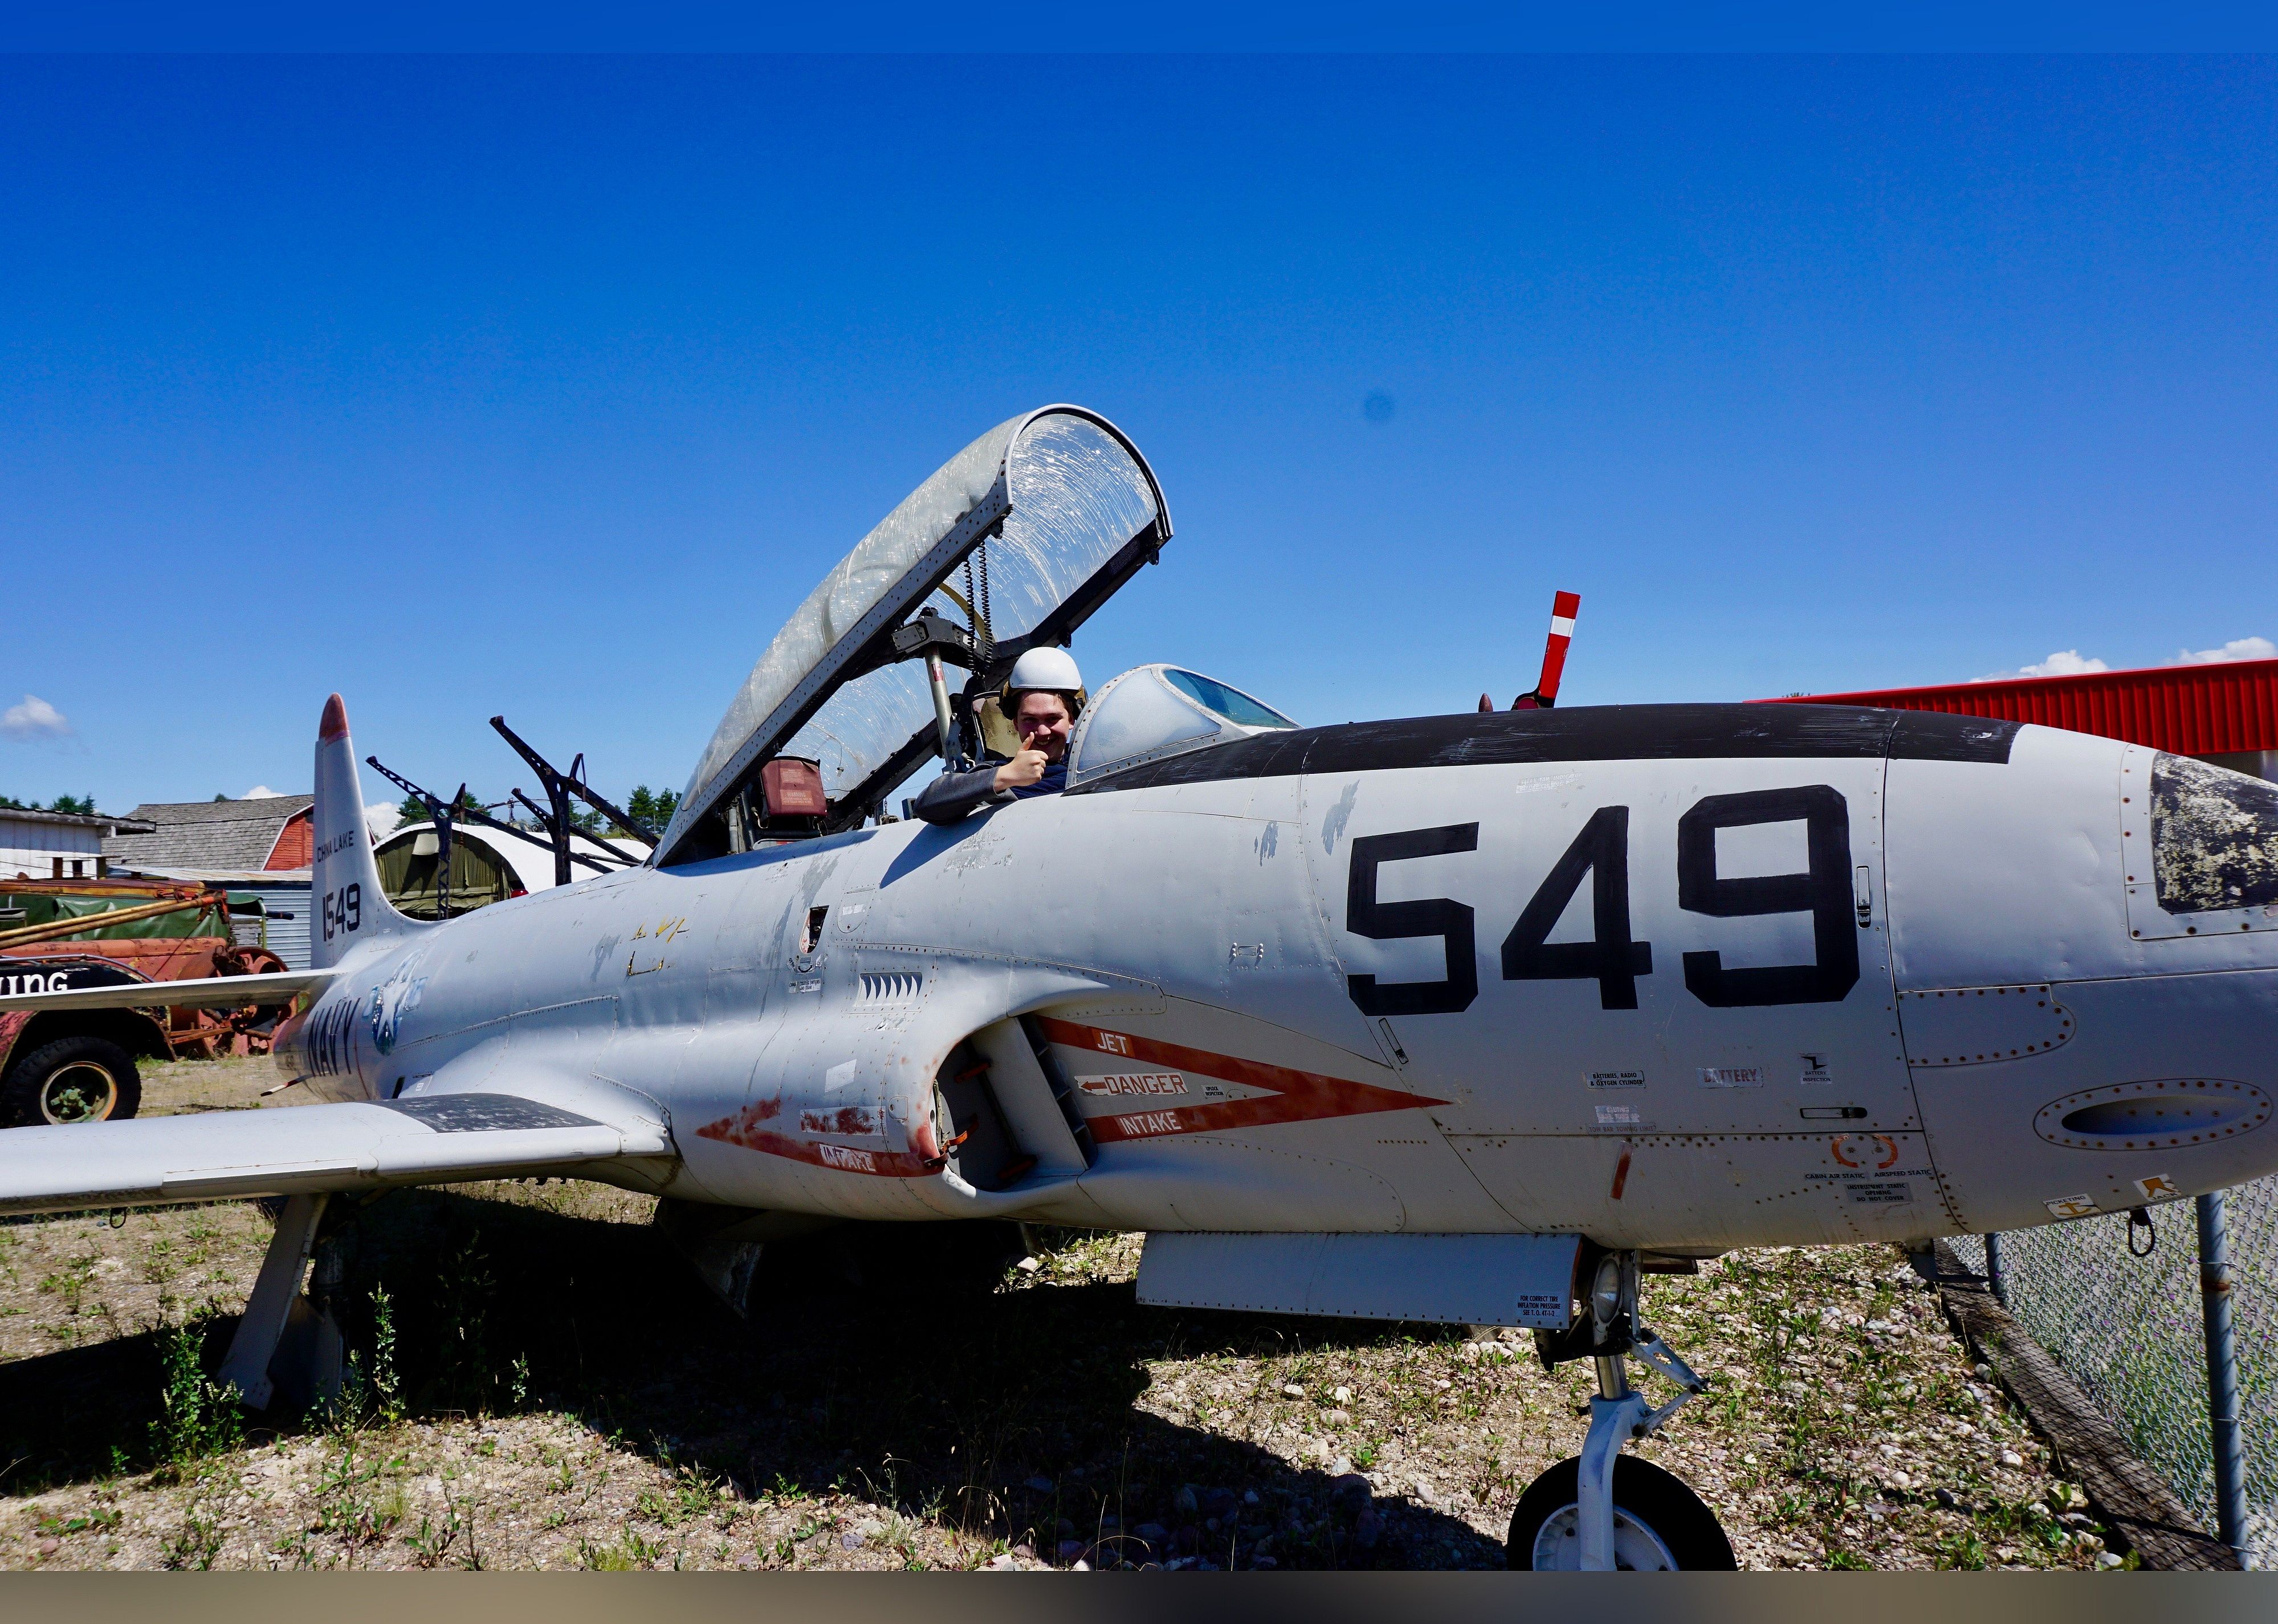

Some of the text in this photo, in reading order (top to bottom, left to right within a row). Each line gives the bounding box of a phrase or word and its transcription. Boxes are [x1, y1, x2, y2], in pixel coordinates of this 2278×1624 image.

[317, 830, 354, 863] CHINA LAKE
[323, 882, 360, 942] 1549
[1347, 785, 1860, 1016] 549
[308, 997, 361, 1076] NAVY
[1098, 1032, 1127, 1054] JET
[1103, 1074, 1188, 1093] DANGER
[1704, 1068, 1757, 1082] BATTERY
[1119, 1111, 1181, 1135] INTAKE
[2045, 1195, 2086, 1206] PICKETING
